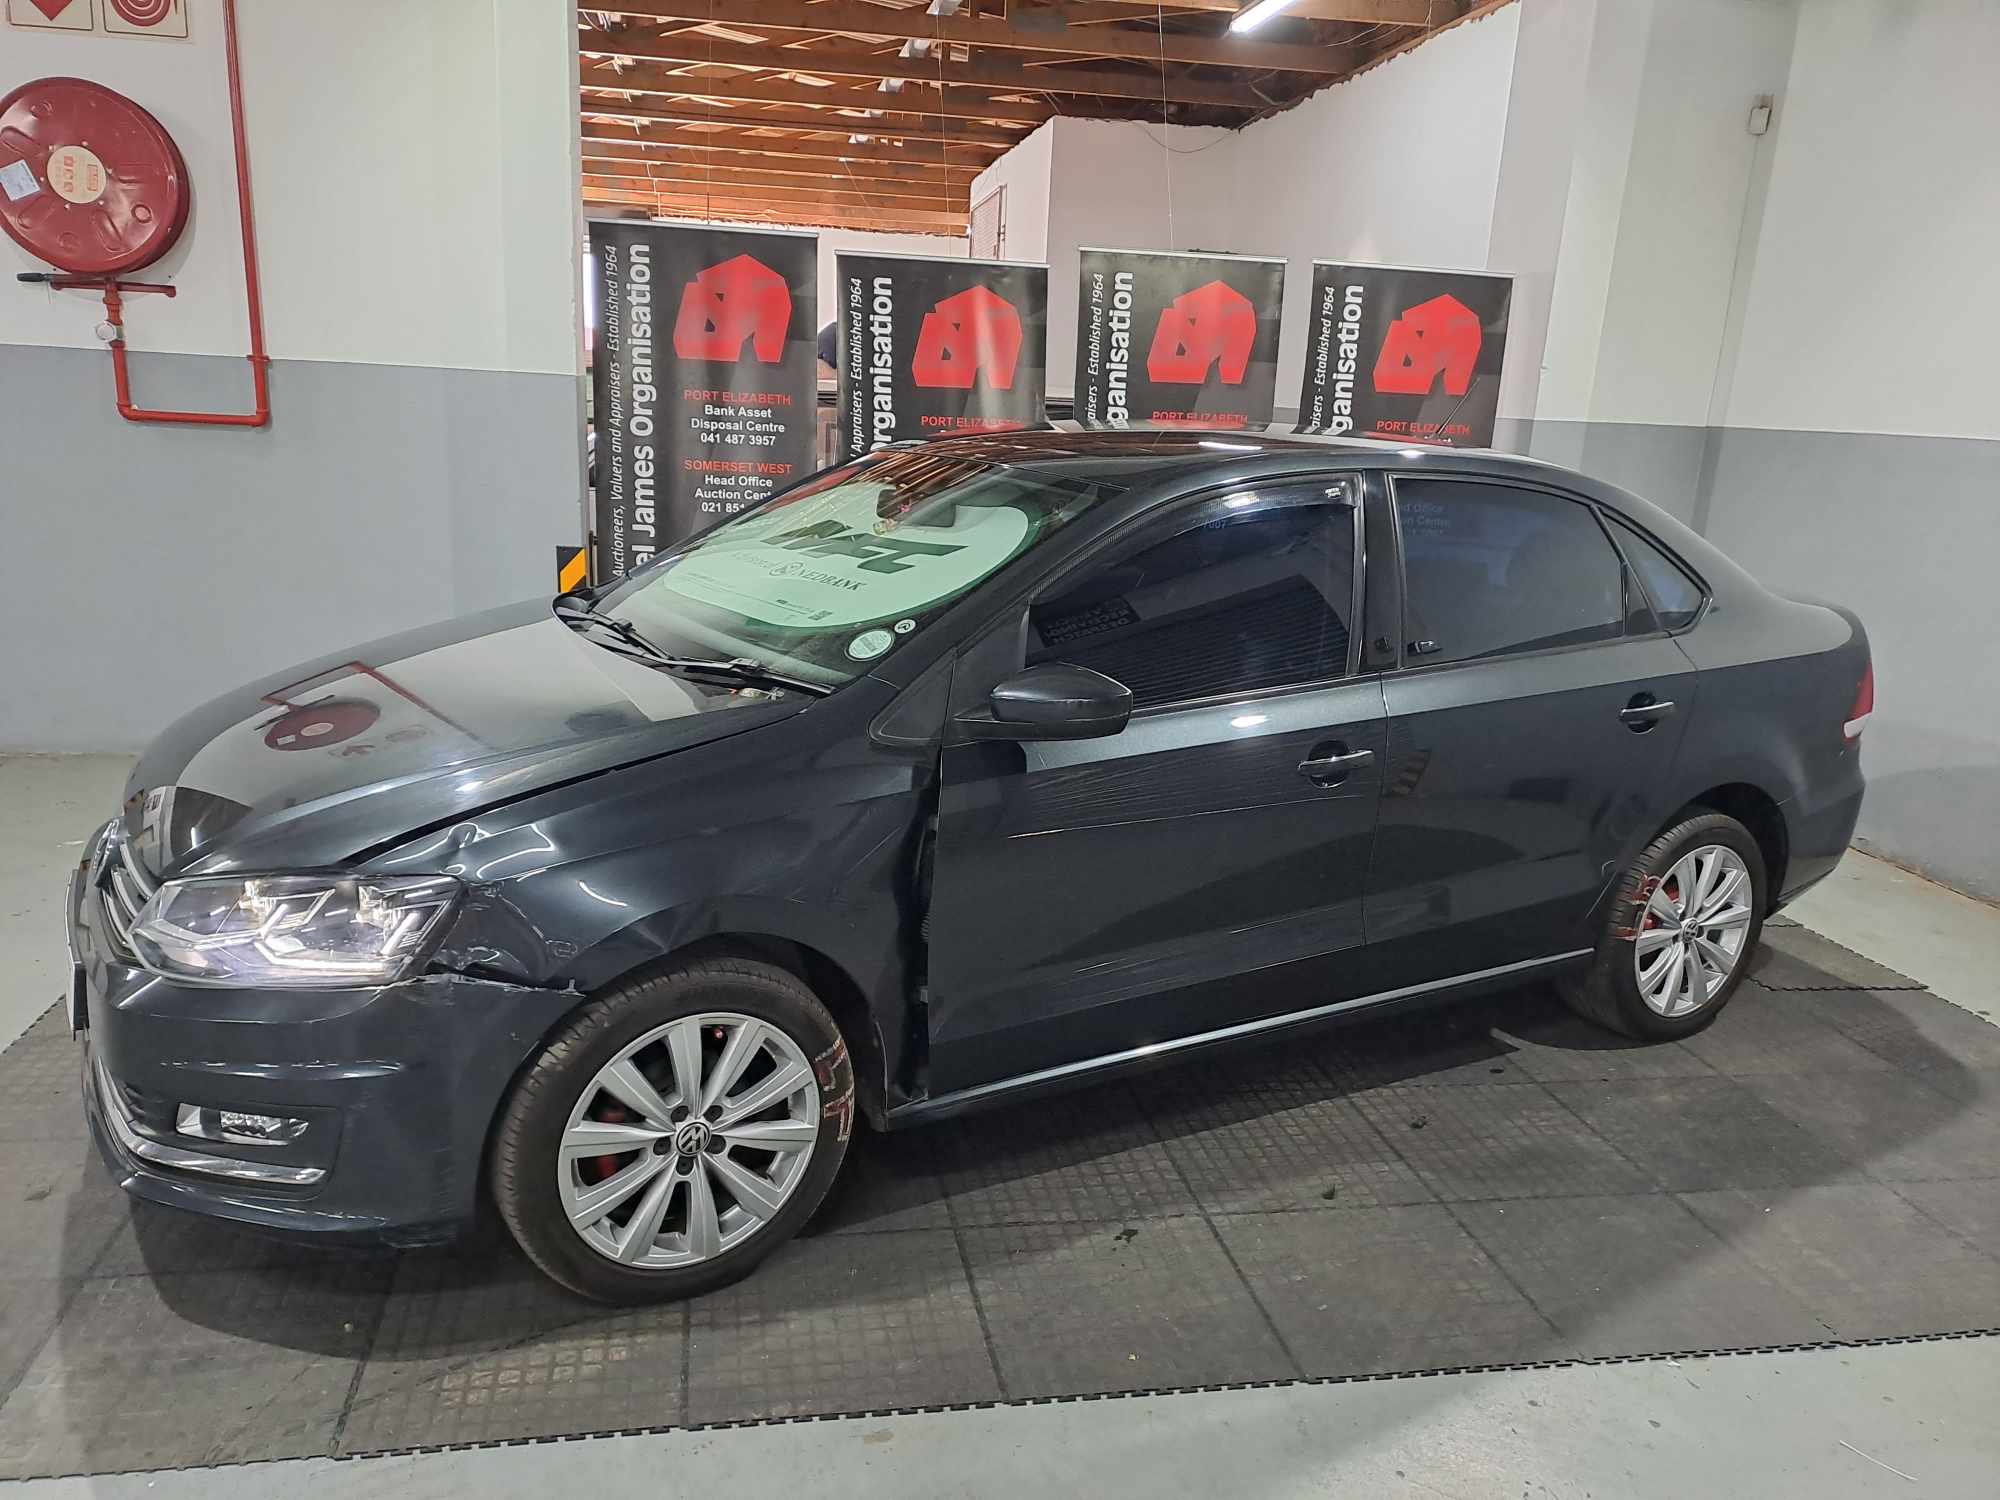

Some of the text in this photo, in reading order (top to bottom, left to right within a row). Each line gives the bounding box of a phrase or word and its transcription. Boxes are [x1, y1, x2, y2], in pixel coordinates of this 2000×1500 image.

[605, 244, 619, 276] 1964
[850, 278, 862, 308] 1964
[1092, 273, 1104, 304] 1964
[1322, 286, 1335, 315] 1964
[605, 280, 620, 351] Established
[626, 244, 657, 437] Organisation
[849, 311, 862, 380] Established
[1087, 305, 1102, 375] Established
[1314, 318, 1332, 385] Established
[608, 361, 625, 427] Appraisers
[684, 389, 792, 405] PORT ELIZABETH
[691, 418, 785, 432] Disposal Centre
[704, 405, 772, 418] Bank Asset
[850, 390, 864, 453] Appraisers
[921, 415, 953, 426] PORT
[1376, 420, 1408, 431] PORT
[608, 428, 622, 453] and
[700, 433, 776, 446] 041 487 3957
[610, 455, 623, 501] Valuers
[684, 460, 792, 474] SOMERSET WEST
[704, 475, 773, 487] Head Office
[632, 445, 656, 538] James
[694, 488, 740, 500] Auction
[701, 502, 721, 512] 021
[610, 505, 625, 577] Auctioneers,
[798, 568, 868, 592] NEDBANK
